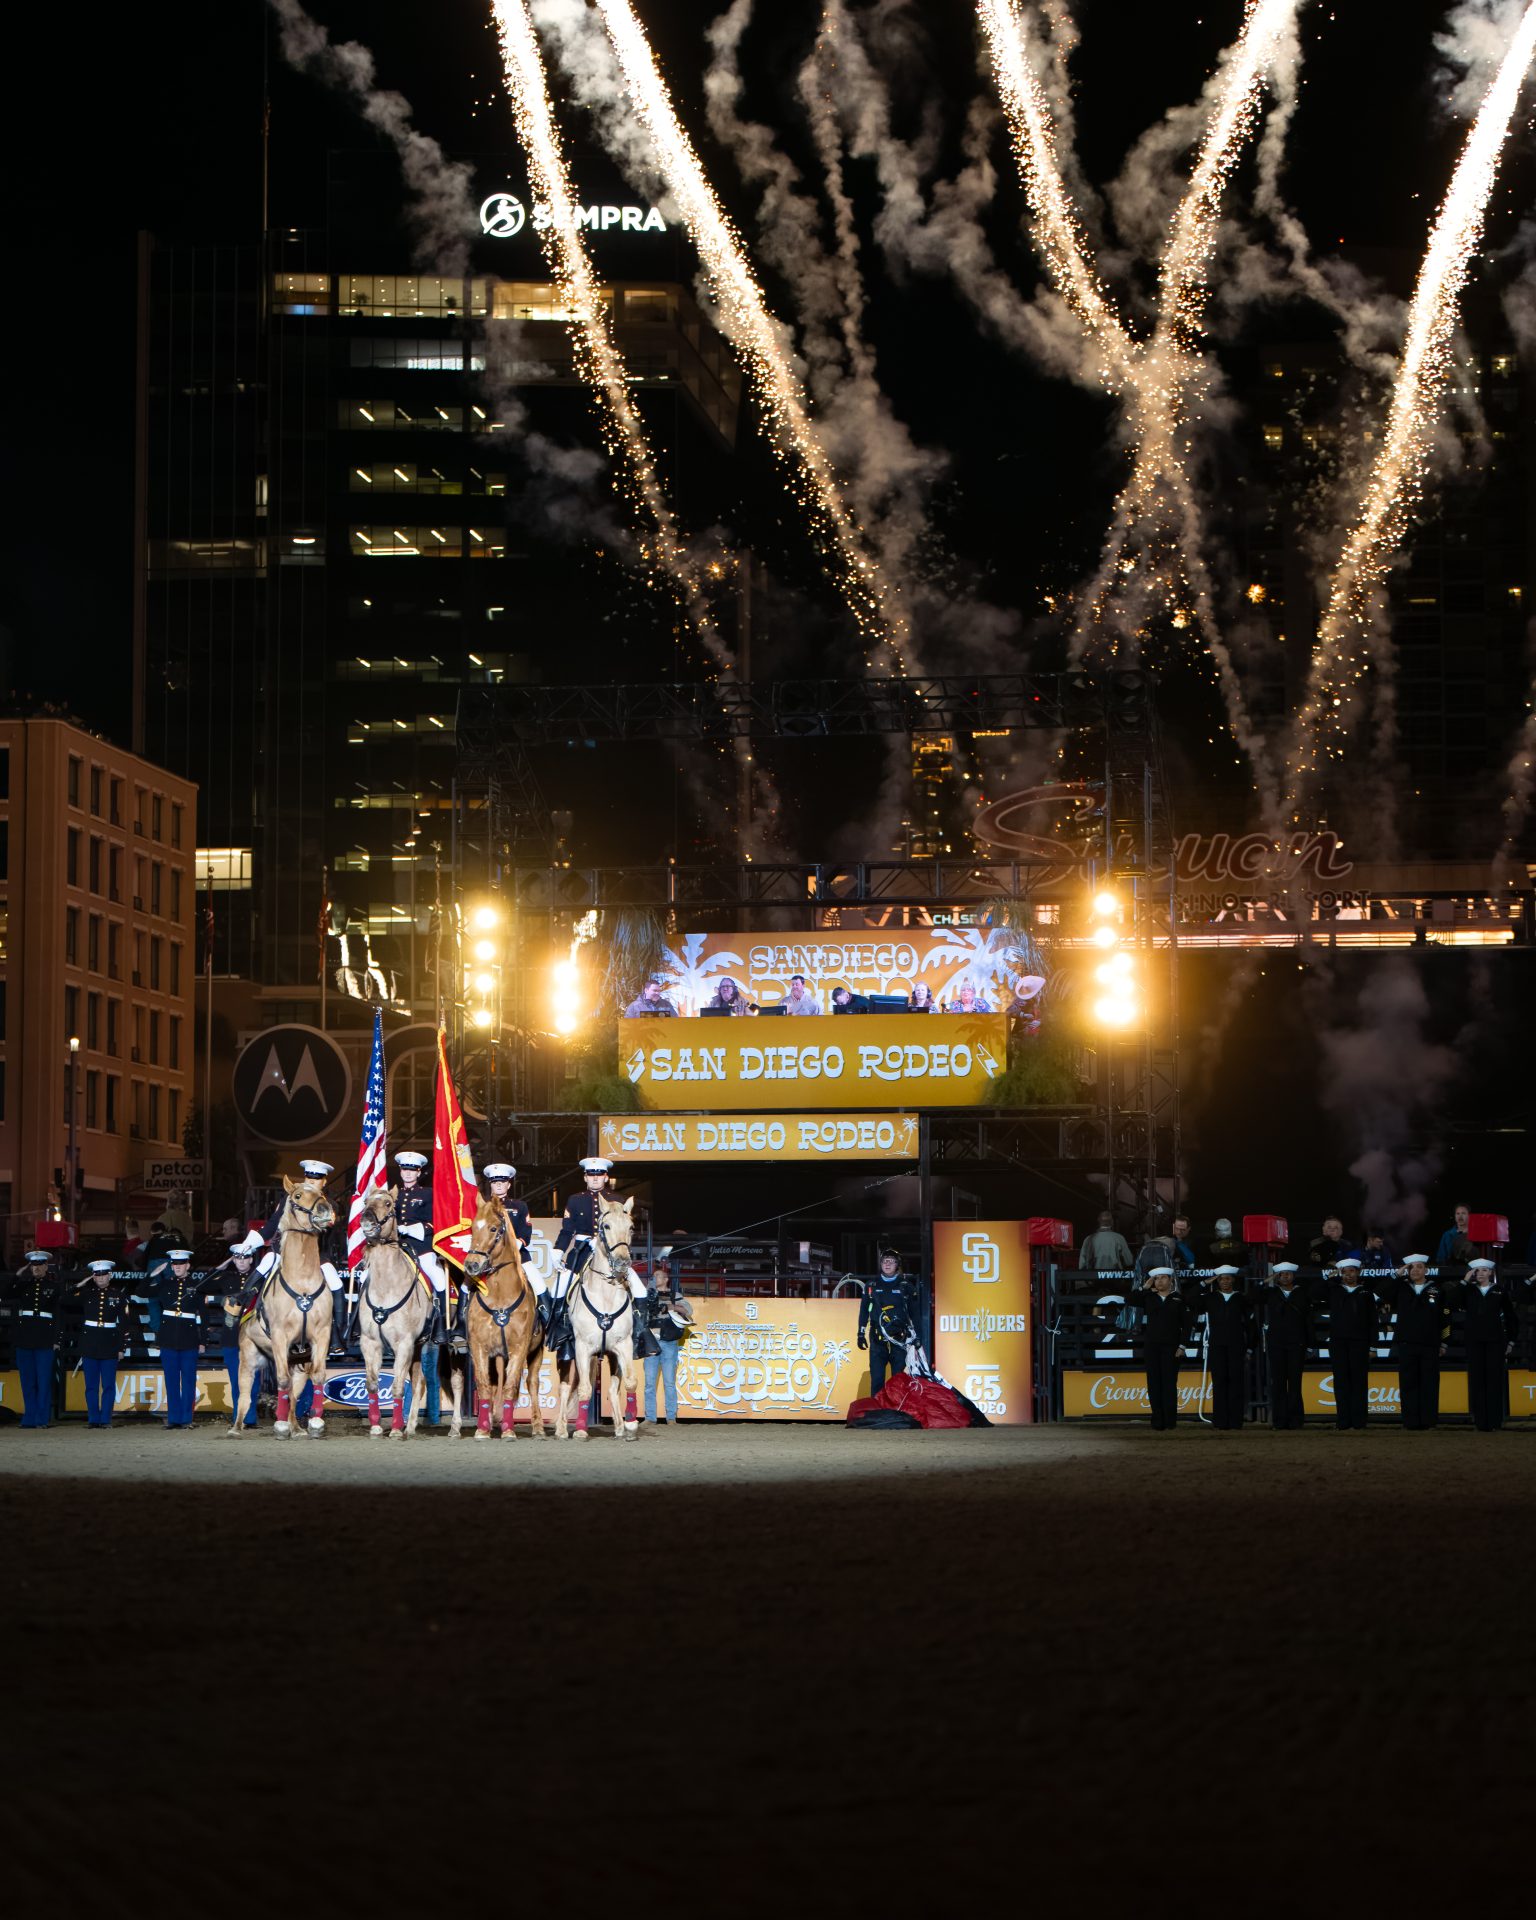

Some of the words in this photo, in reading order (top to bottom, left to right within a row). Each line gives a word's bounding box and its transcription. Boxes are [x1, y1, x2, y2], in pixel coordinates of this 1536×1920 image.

[820, 943, 918, 977] DIEGO
[650, 1048, 726, 1081] SAN
[739, 1045, 845, 1080] DIEGO
[858, 1043, 973, 1081] RODEO
[620, 1123, 686, 1151] SAN
[697, 1122, 786, 1151] DIEGO
[797, 1121, 895, 1153] RODEO
[152, 1161, 203, 1178] petco
[731, 1245, 764, 1254] Moreno
[742, 1331, 818, 1361] DIEGO
[339, 1376, 394, 1400] Fod
[687, 1356, 820, 1404] RODEO
[964, 1374, 1002, 1401] C5
